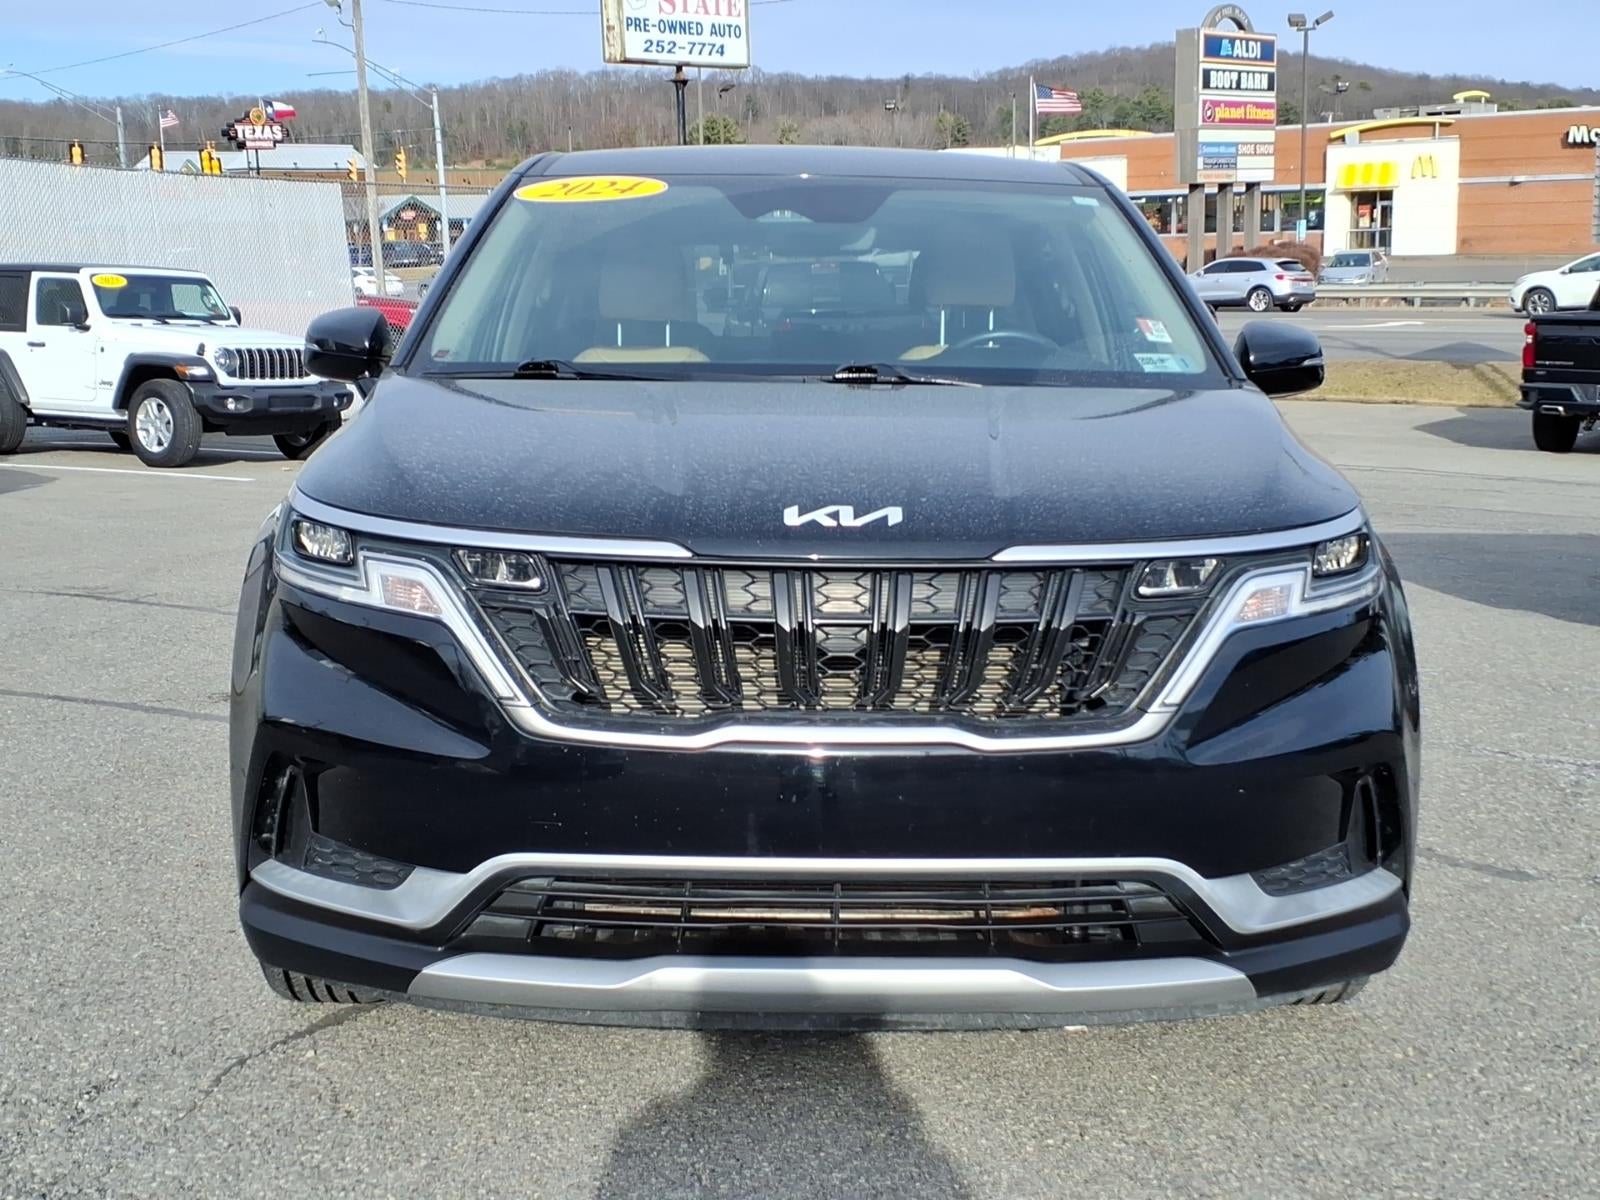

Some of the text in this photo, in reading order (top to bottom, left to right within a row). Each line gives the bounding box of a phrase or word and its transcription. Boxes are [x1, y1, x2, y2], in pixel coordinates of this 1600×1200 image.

[626, 16, 742, 39] PRE-OWNED AUTO
[643, 39, 725, 57] 252-7774
[1232, 39, 1262, 59] ALDI
[1209, 70, 1269, 91] BOOT BARN
[1214, 102, 1275, 122] planet fitness
[234, 124, 283, 141] TEXAS
[1237, 143, 1255, 154] SHOE
[1255, 144, 1274, 155] SHOW
[538, 179, 648, 197] 2024
[783, 504, 903, 527] KIA
